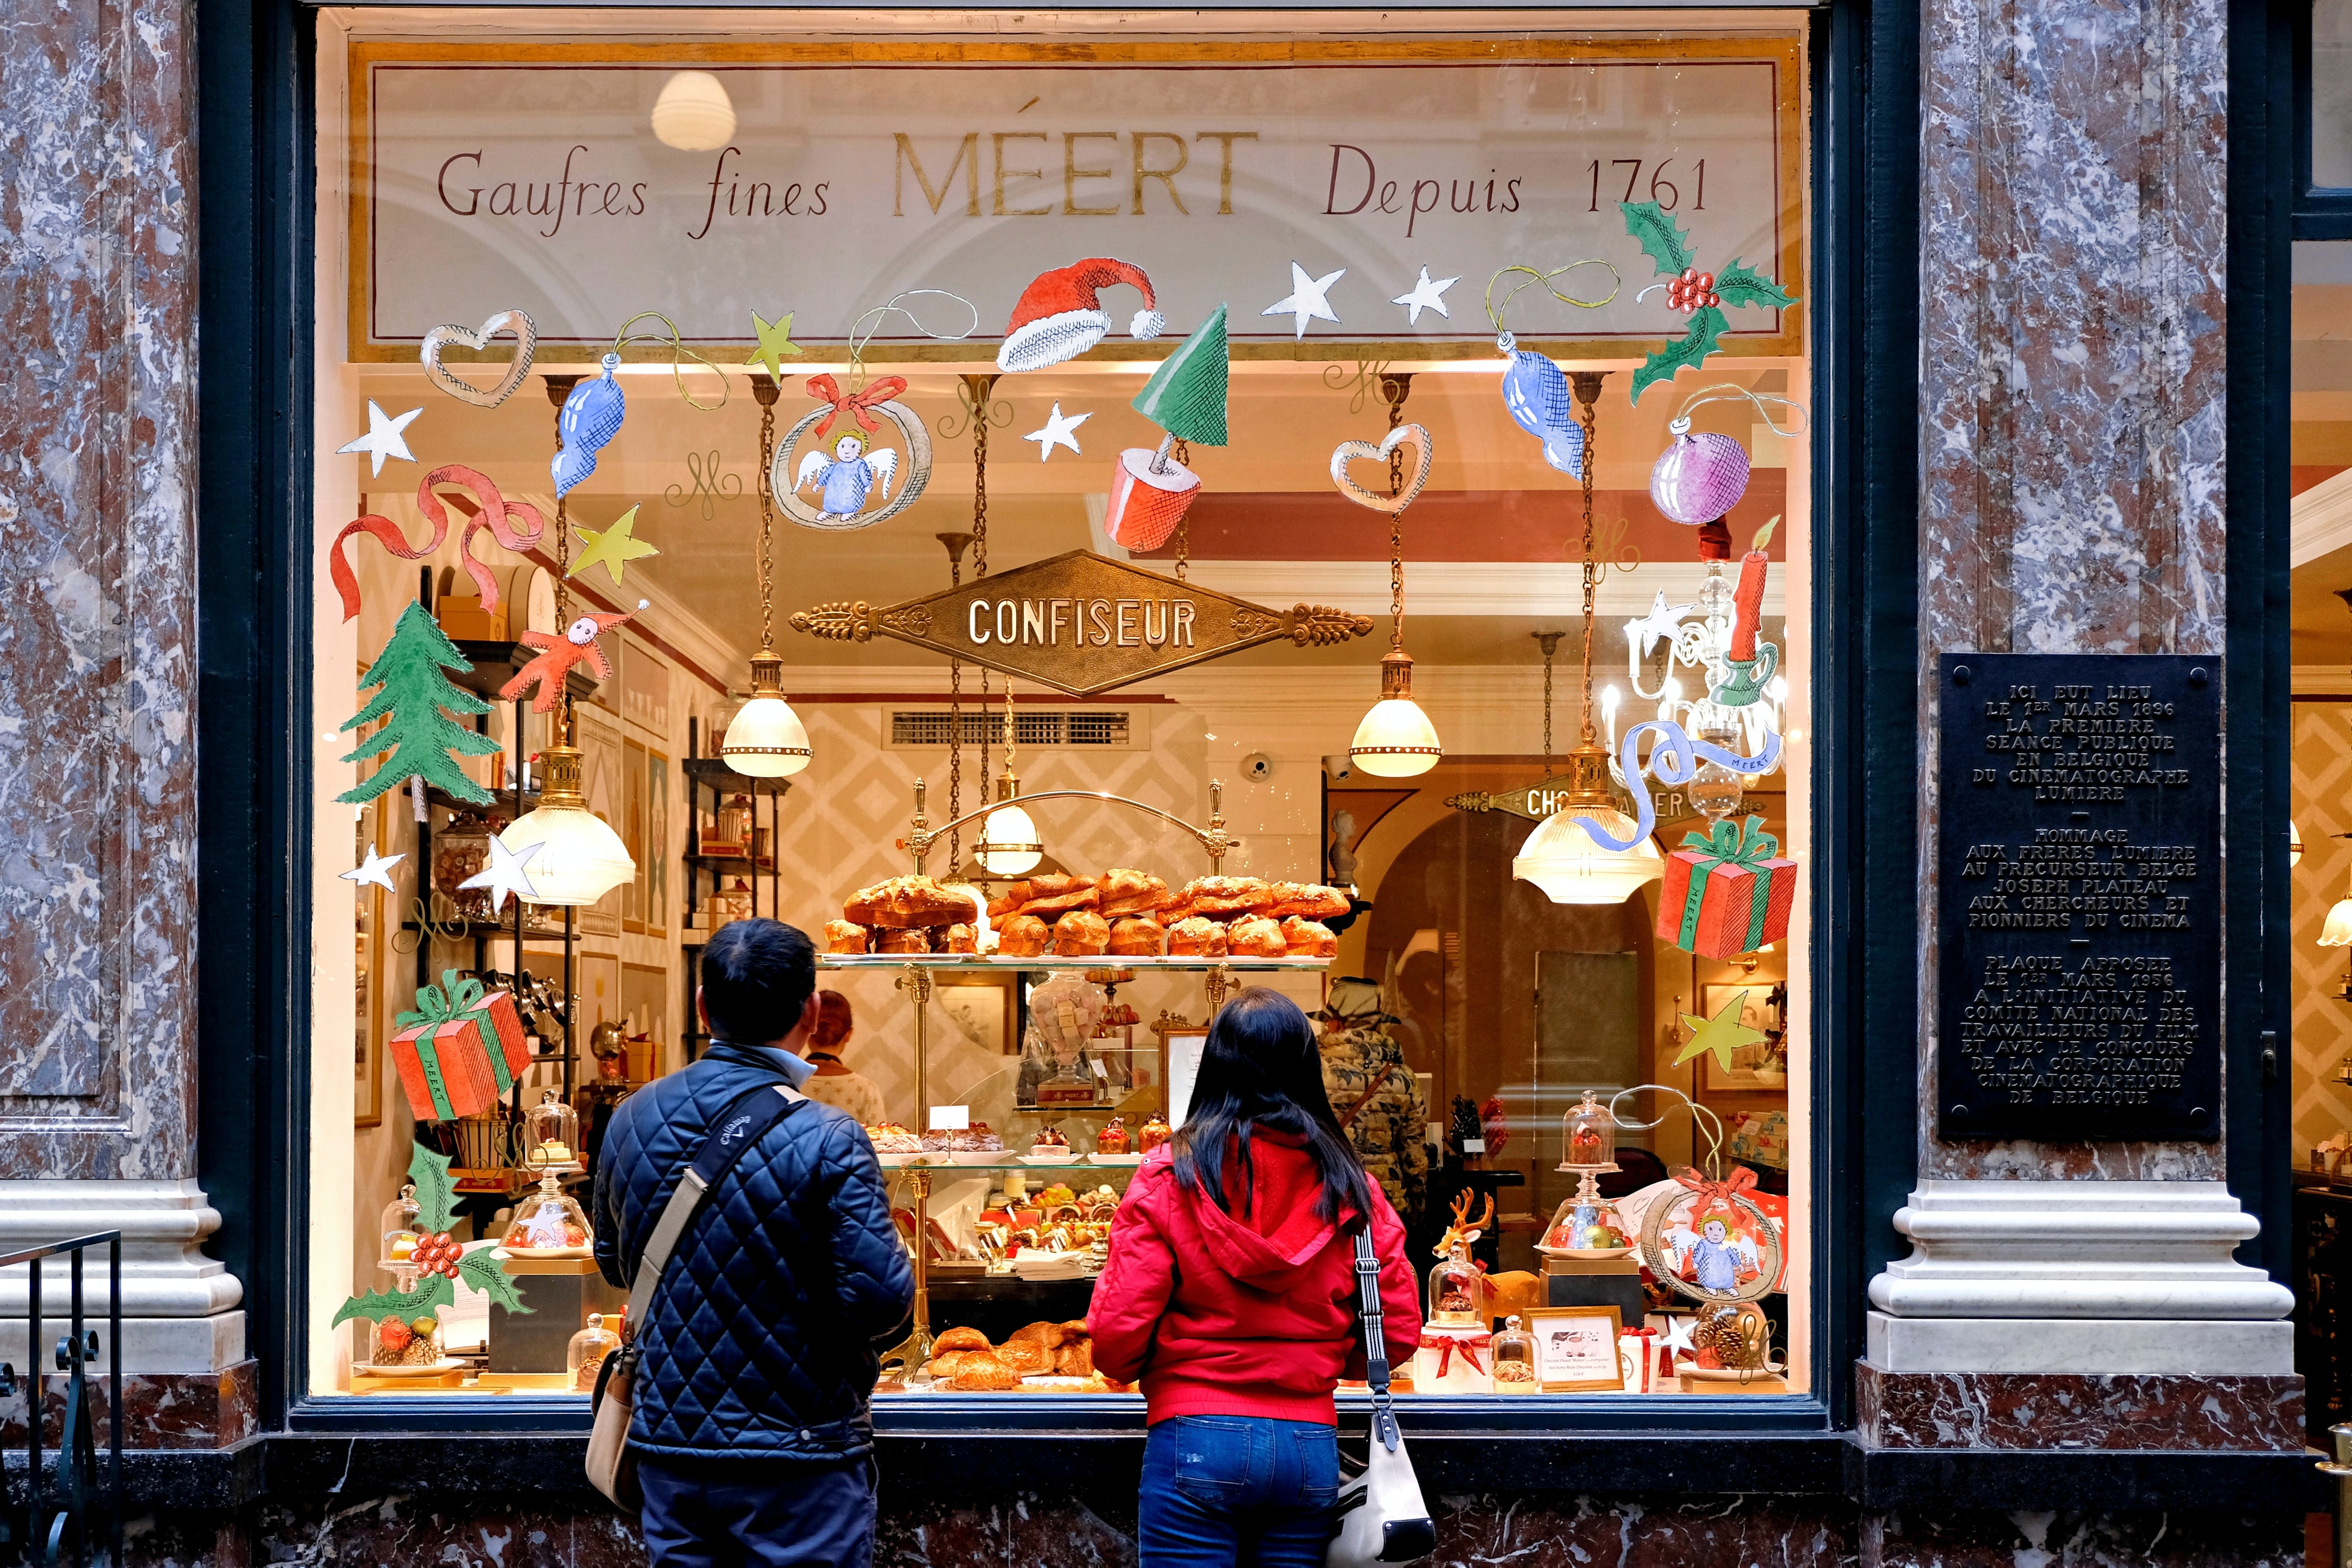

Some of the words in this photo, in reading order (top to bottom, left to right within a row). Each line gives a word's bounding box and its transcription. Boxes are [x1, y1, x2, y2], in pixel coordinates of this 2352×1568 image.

[437, 145, 648, 238] Gaufres
[687, 146, 830, 240] fines
[892, 95, 1259, 216] MÉERT
[1320, 144, 1522, 238] Depuis
[1587, 158, 1706, 212] 1761
[968, 598, 1197, 646] CONFISEUR
[2009, 685, 2037, 699] ICI
[2054, 684, 2094, 700] EUT
[2107, 684, 2152, 700] LIEU
[1985, 700, 2010, 716] LE
[2024, 701, 2051, 716] 1ER
[2064, 702, 2119, 716] MARS
[2132, 701, 2174, 717] 1896
[2006, 718, 2033, 733] LA
[2048, 718, 2154, 734] PREMIERE
[1986, 734, 2063, 750] SEANCE
[2077, 734, 2174, 752] PUBLIQUE
[1731, 755, 1768, 769] MEERT
[2016, 752, 2044, 766] EN
[2053, 751, 2149, 769] BELGIQUE
[1972, 768, 1997, 782] DU
[2008, 768, 2189, 784] CINEMATOGRAPHE
[2035, 786, 2125, 800] LUMIERE
[2035, 827, 2128, 843] HOMMAGE
[1965, 843, 2006, 859] AUX
[2019, 845, 2096, 860] FRERES
[2111, 844, 2196, 861] LUMIERE
[1961, 862, 1987, 876] AU
[1998, 861, 2127, 877] PRECURSEUR
[2137, 862, 2196, 877] BELGE
[1993, 879, 2069, 894] JOSEPH
[2082, 879, 2168, 894] PLATEAU
[1685, 886, 1700, 932] MEERT
[1968, 895, 2009, 910] AUX
[2021, 896, 2149, 911] CHERCHEURS
[2165, 895, 2190, 911] ET
[1969, 913, 2071, 928] PIONNIERS
[2085, 913, 2109, 928] DU
[2119, 913, 2191, 928] CINEMA
[1985, 956, 2062, 973] PLAQUE
[2080, 956, 2171, 972] APPOSEE
[1984, 972, 2009, 986] LE
[2020, 971, 2048, 987] 1ER
[2060, 972, 2116, 987] MARS
[2131, 971, 2173, 988] 1956
[1973, 989, 1989, 1003] A
[2002, 989, 2146, 1004] L'INITIATIVE
[2162, 988, 2187, 1004] DU
[1964, 1005, 2039, 1022] COMITE
[2051, 1006, 2148, 1021] NATIONAL
[2159, 1006, 2195, 1022] DES
[1960, 1022, 2109, 1039] TRAVAILLEURS
[2120, 1021, 2144, 1038] DU
[2155, 1021, 2199, 1039] FILM
[1961, 1039, 1986, 1055] ET
[1995, 1040, 2044, 1054] AVEC
[2058, 1040, 2080, 1054] LE
[2096, 1038, 2193, 1055] CONCOURS
[1971, 1055, 1995, 1070] DE
[2009, 1056, 2035, 1071] LA
[2049, 1057, 2186, 1072] CORPORATION
[425, 1060, 445, 1101] MEERT
[1978, 1072, 2181, 1090] CINEMATOGRAPHIQUE
[2010, 1090, 2033, 1104] DE
[2052, 1090, 2149, 1106] BELGIQUE
